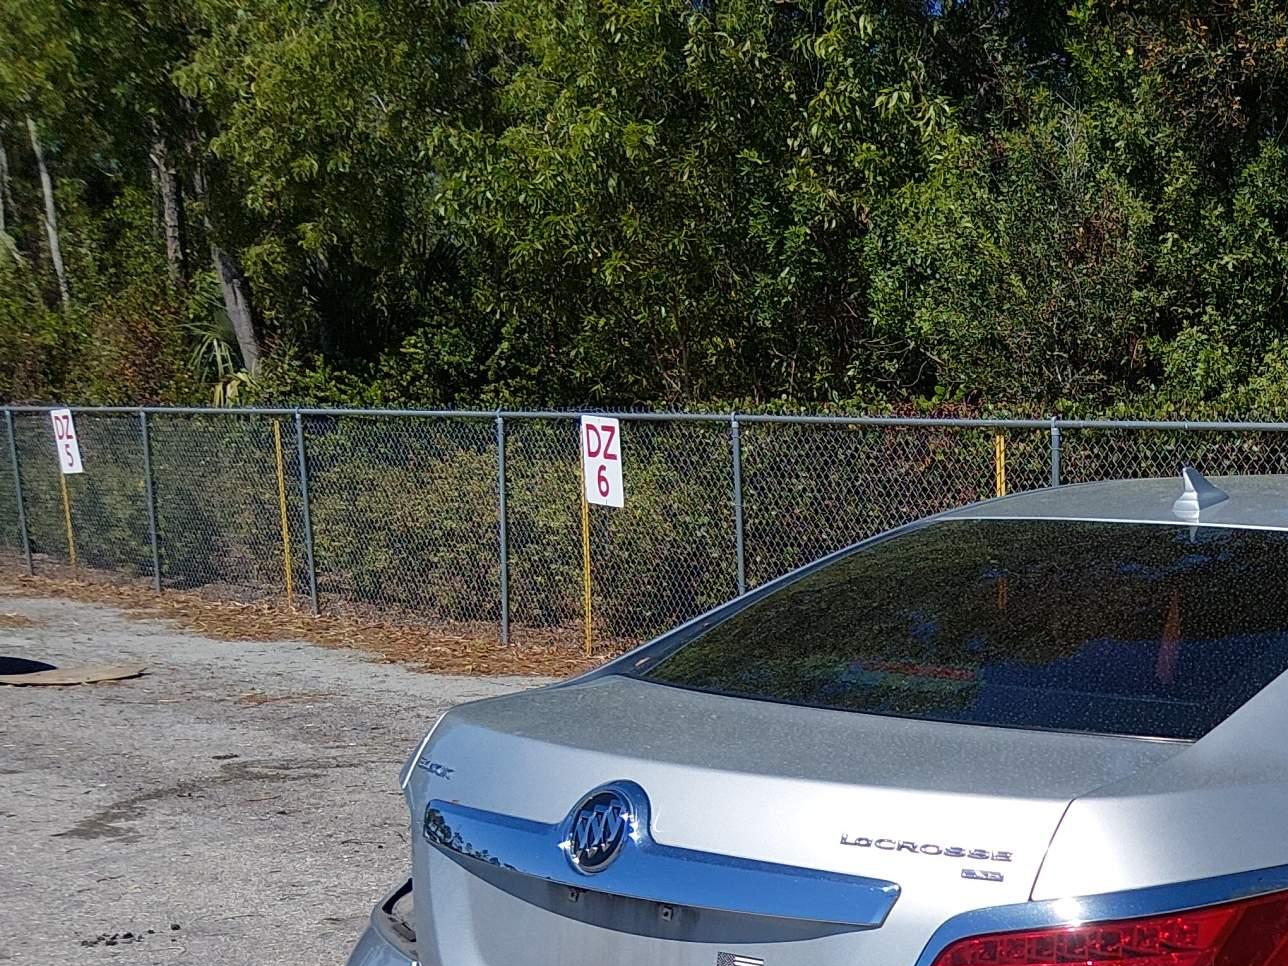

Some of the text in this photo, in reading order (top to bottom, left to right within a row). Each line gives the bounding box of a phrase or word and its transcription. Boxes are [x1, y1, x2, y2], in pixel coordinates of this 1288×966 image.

[54, 415, 74, 440] DZ
[585, 423, 618, 460] DZ
[65, 444, 74, 467] 5
[597, 464, 610, 497] 6
